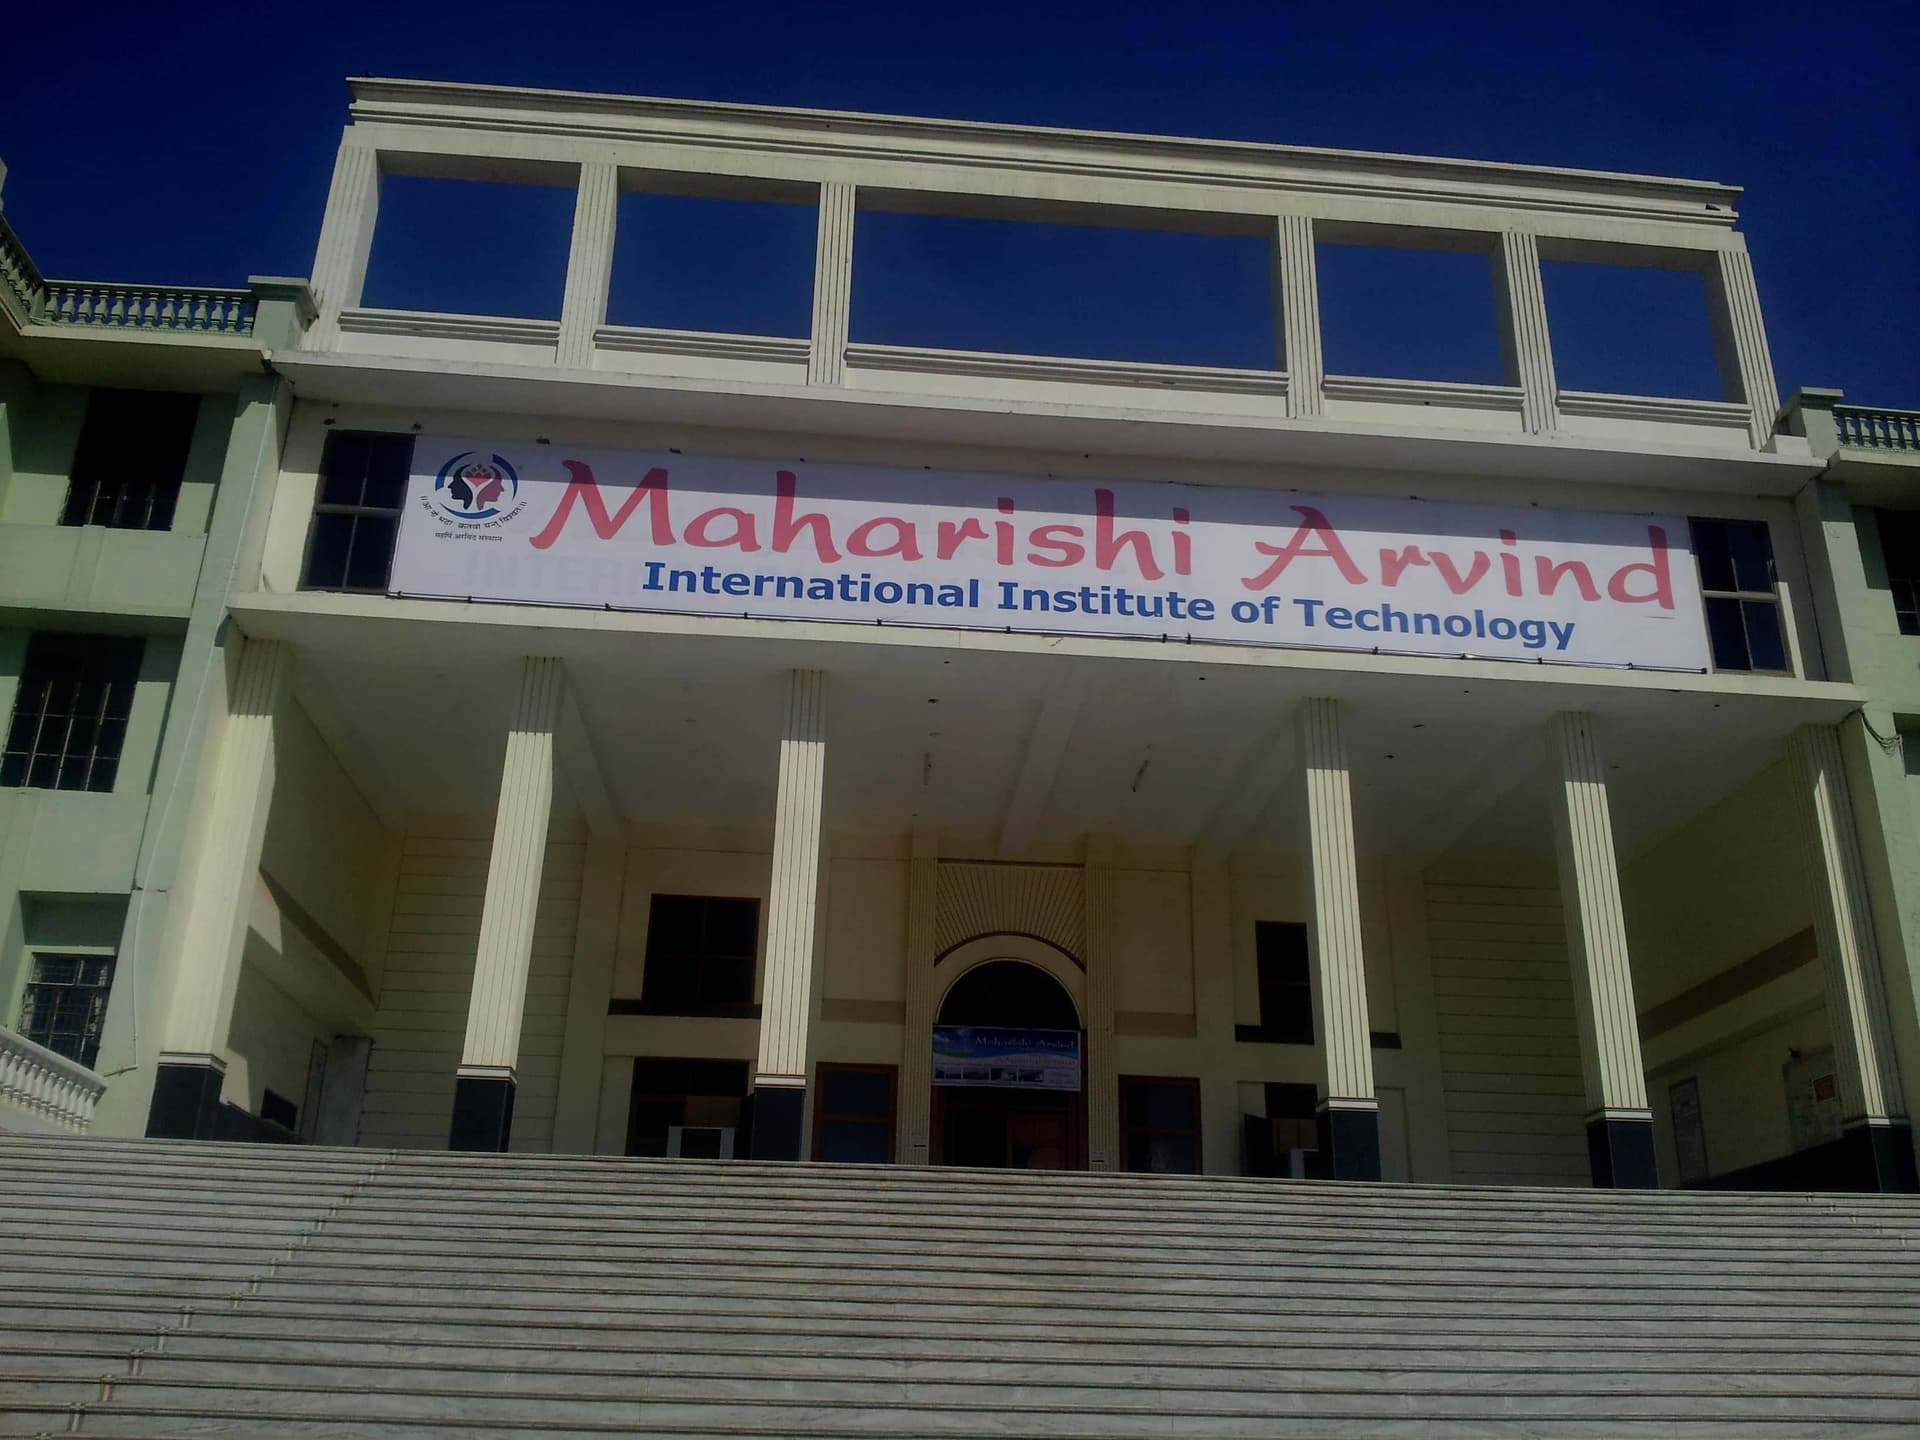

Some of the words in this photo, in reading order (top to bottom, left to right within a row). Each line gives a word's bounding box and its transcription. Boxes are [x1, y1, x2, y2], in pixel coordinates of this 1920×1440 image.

[531, 480, 1192, 581] Maharishi
[1242, 505, 1675, 610] Arvind
[642, 561, 979, 609] International
[997, 581, 1216, 622] Institute
[1230, 594, 1282, 626] of
[1293, 597, 1577, 650] Technology
